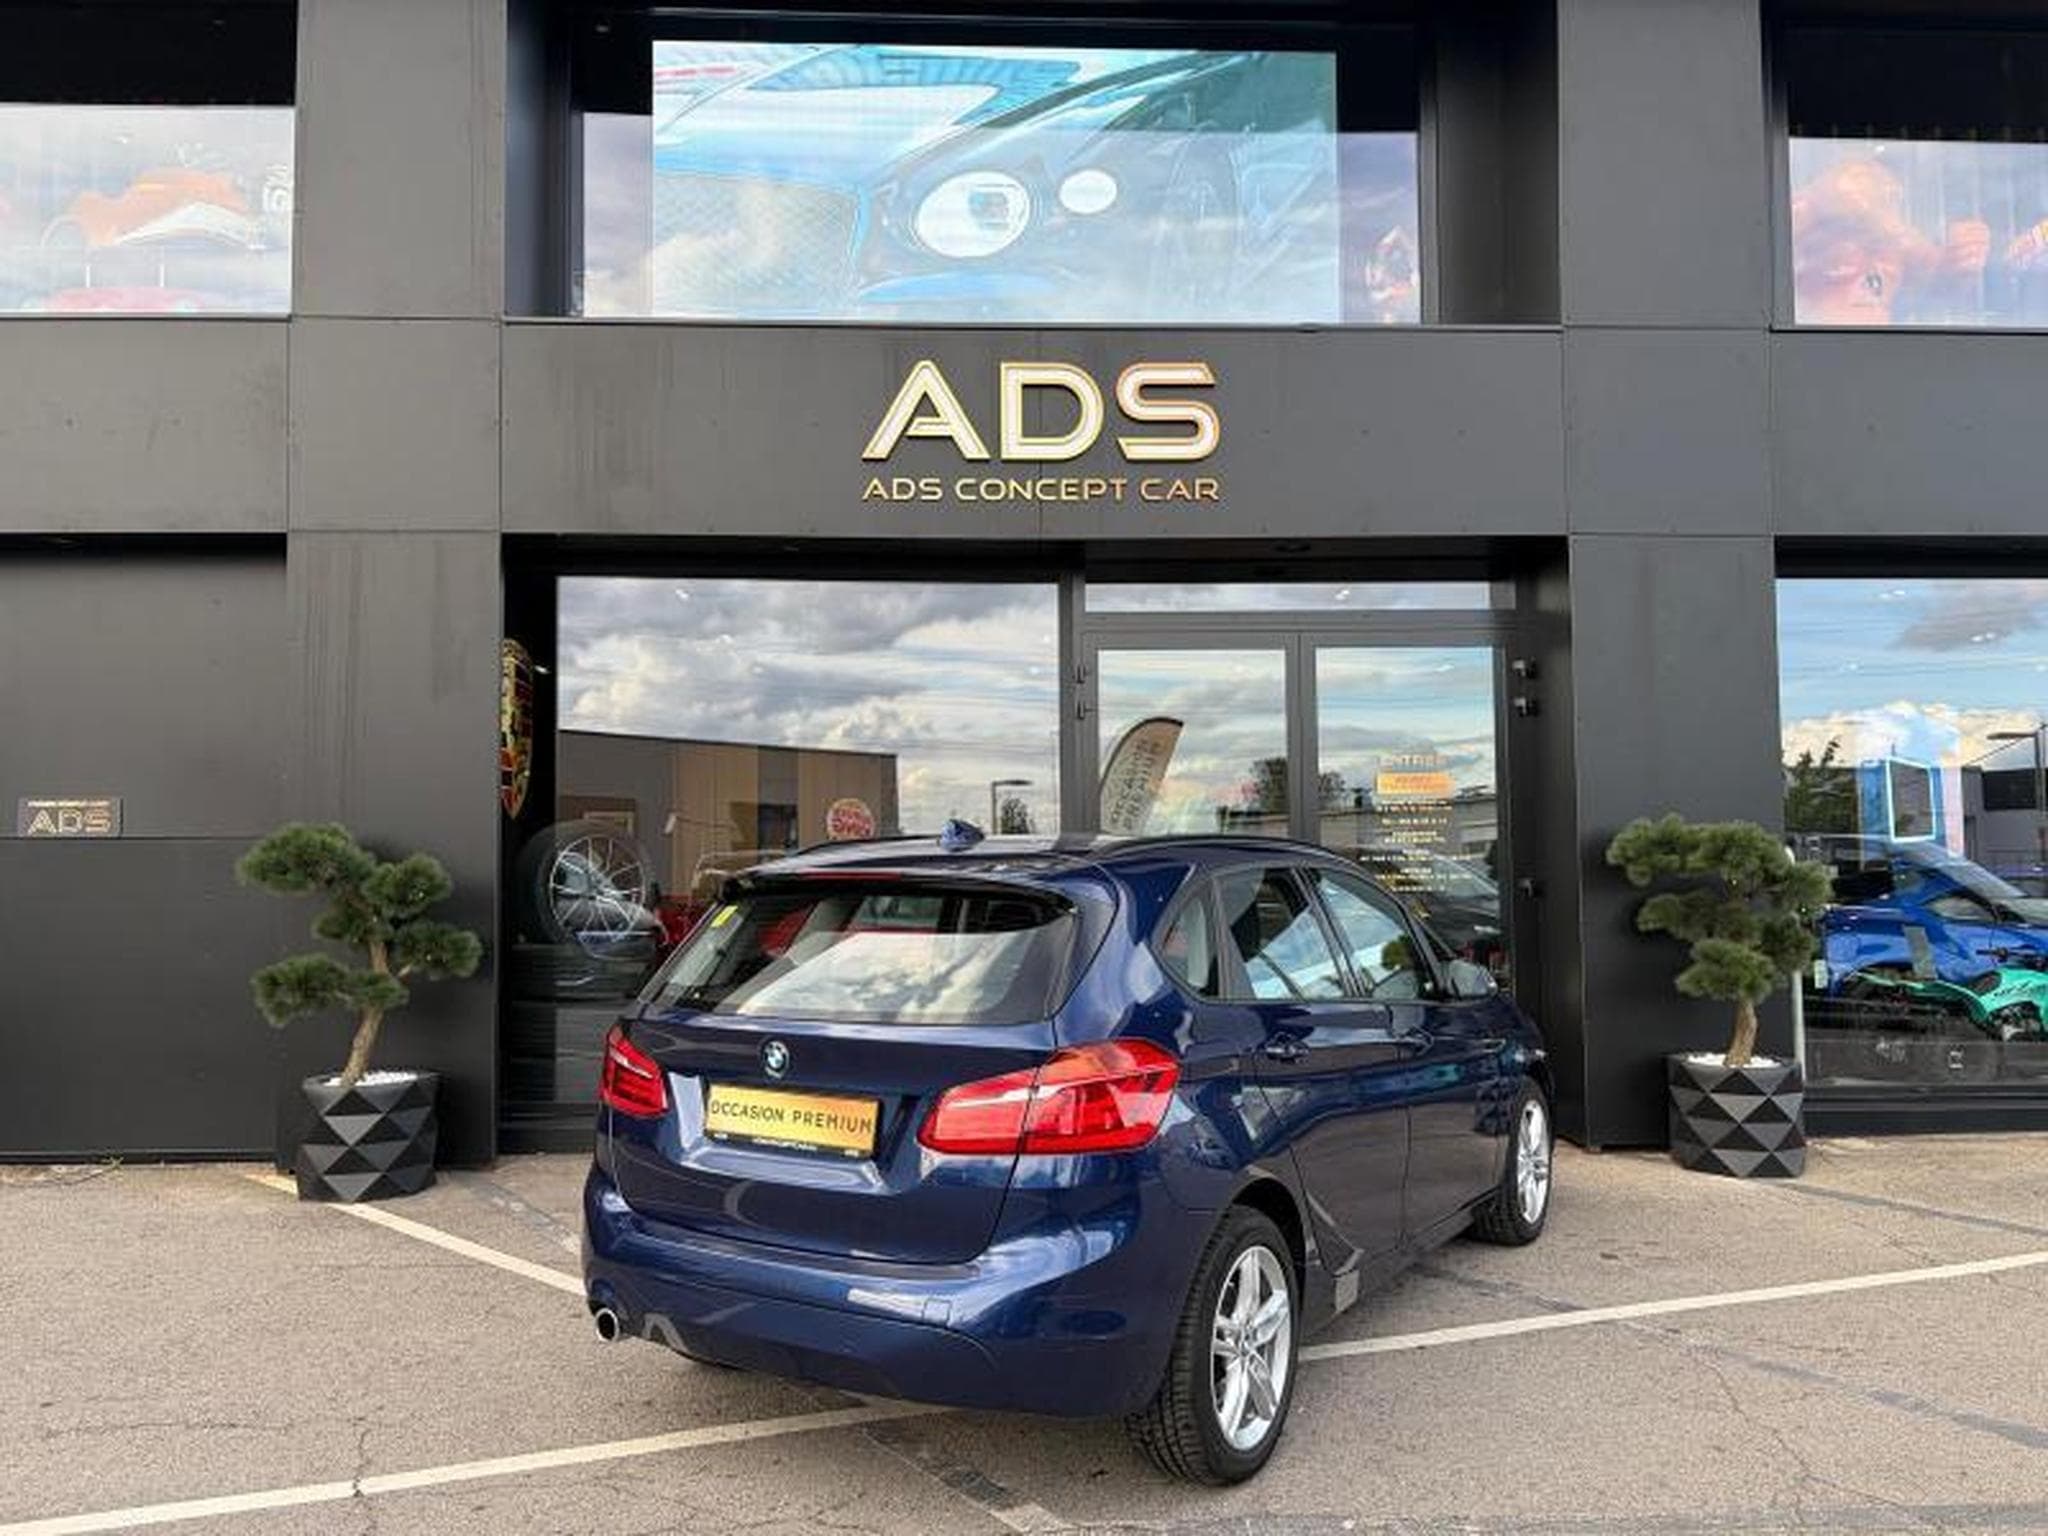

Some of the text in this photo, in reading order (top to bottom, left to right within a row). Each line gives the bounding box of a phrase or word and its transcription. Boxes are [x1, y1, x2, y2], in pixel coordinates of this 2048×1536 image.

[861, 360, 1220, 461] ADS
[862, 478, 1220, 501] ADS CONCEPT CAR
[28, 809, 111, 834] ADS
[711, 1101, 872, 1134] OCCASION PREMIUM
